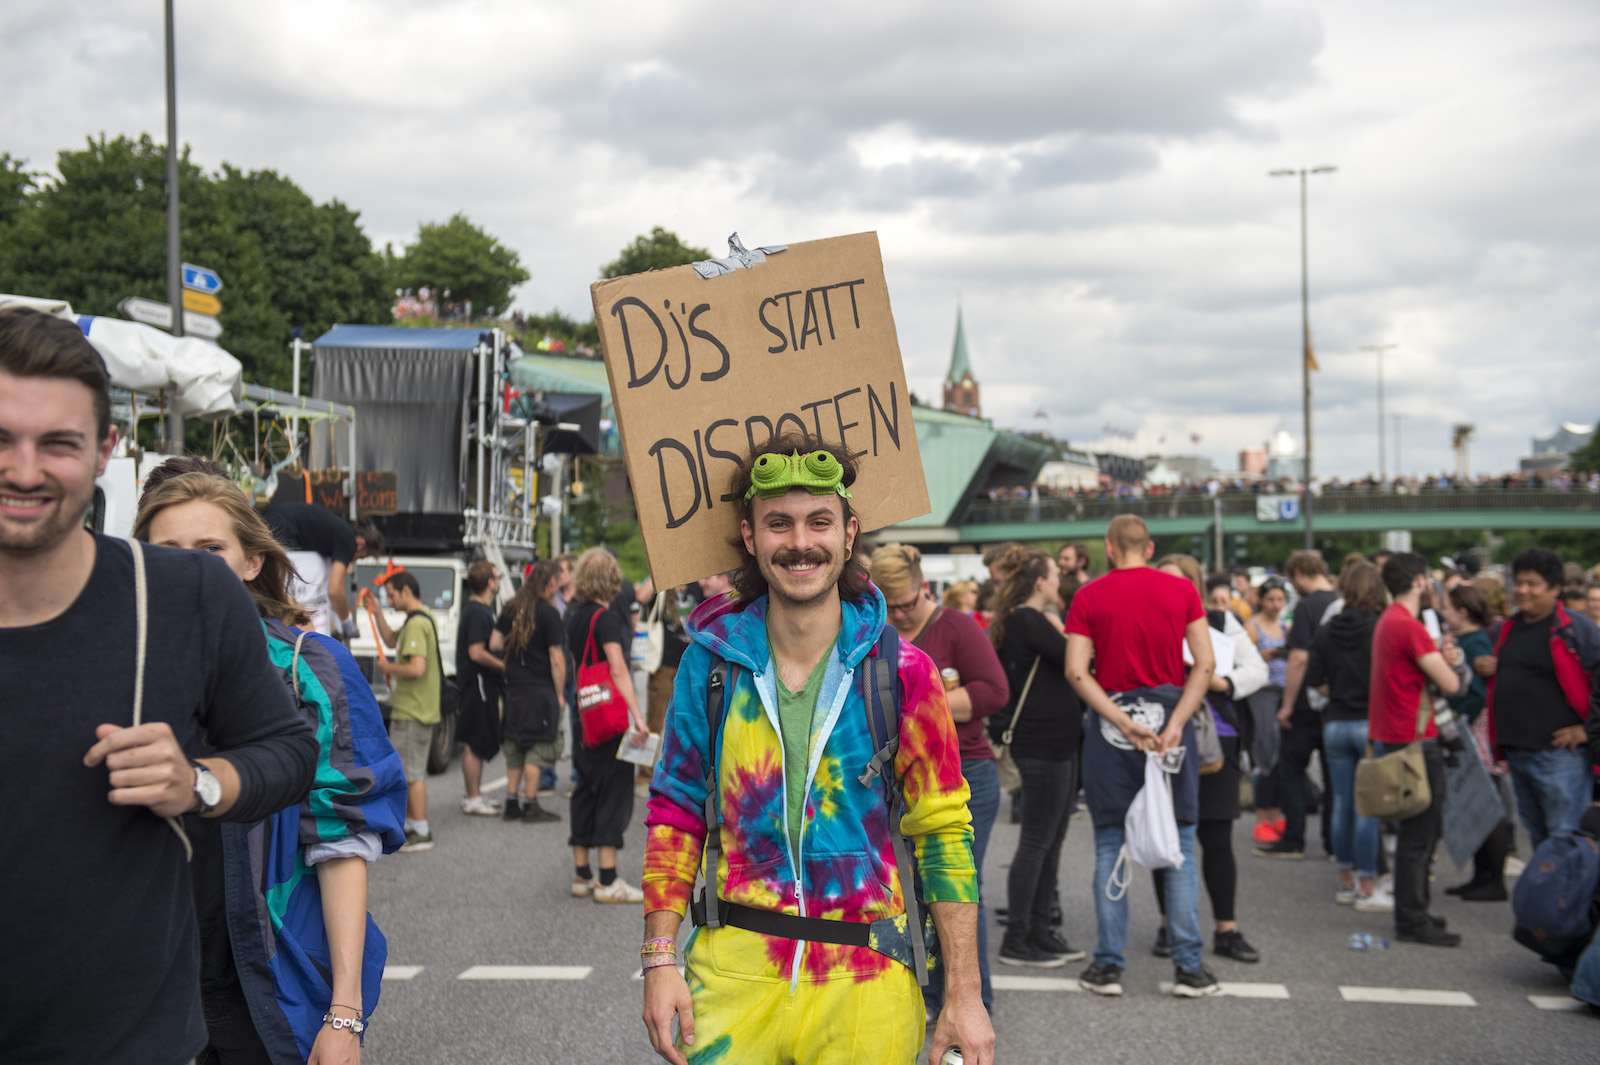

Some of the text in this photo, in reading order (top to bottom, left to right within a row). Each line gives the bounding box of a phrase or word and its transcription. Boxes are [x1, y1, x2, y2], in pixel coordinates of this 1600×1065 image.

[758, 278, 865, 354] STATT
[320, 488, 398, 509] WCOME
[1280, 499, 1299, 519] U
